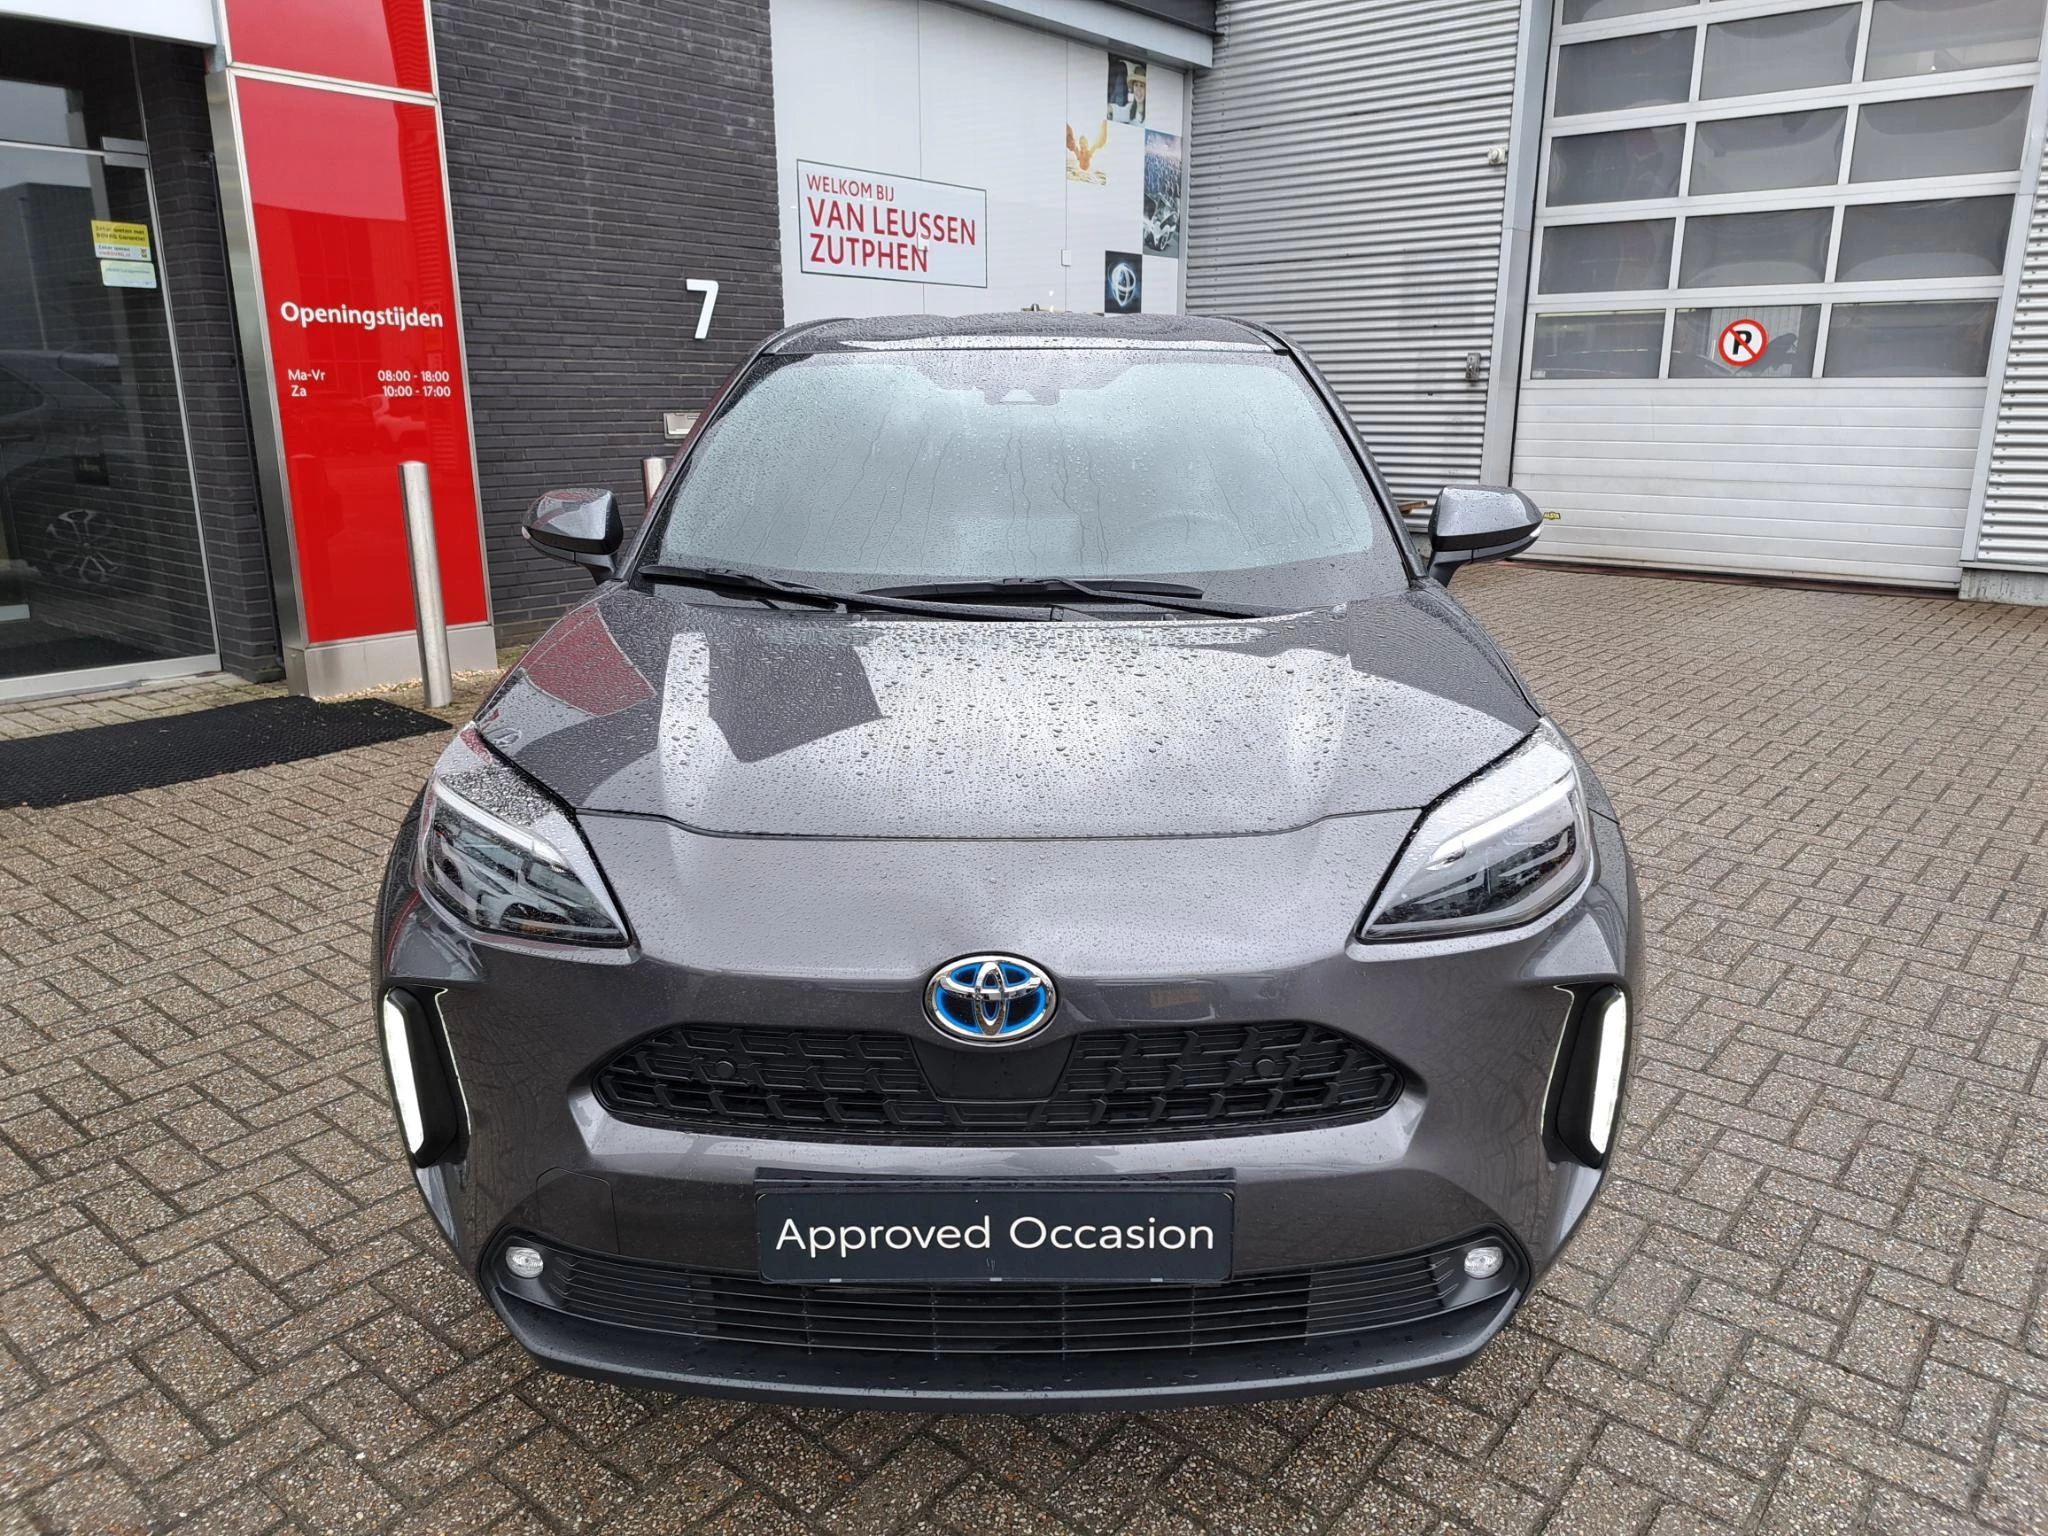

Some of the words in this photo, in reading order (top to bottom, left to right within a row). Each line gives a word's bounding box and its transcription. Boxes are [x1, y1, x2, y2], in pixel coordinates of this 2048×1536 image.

[806, 173, 872, 198] WELKOM
[876, 184, 894, 202] BIJ
[807, 196, 864, 232] VAN
[872, 205, 976, 246] LEUSSEN
[809, 232, 928, 273] ZUTPHEN
[280, 301, 444, 332] Openingstijden
[686, 278, 719, 339] 7
[1732, 330, 1752, 355] P
[287, 368, 326, 381] Ma-Vr
[377, 370, 411, 382] 08:00
[420, 371, 449, 382] 18:00
[291, 385, 307, 397] Za
[382, 386, 413, 397] 10:00
[423, 386, 451, 397] 17:00
[775, 1215, 991, 1258] Approved
[1009, 1216, 1215, 1250] Occasion
